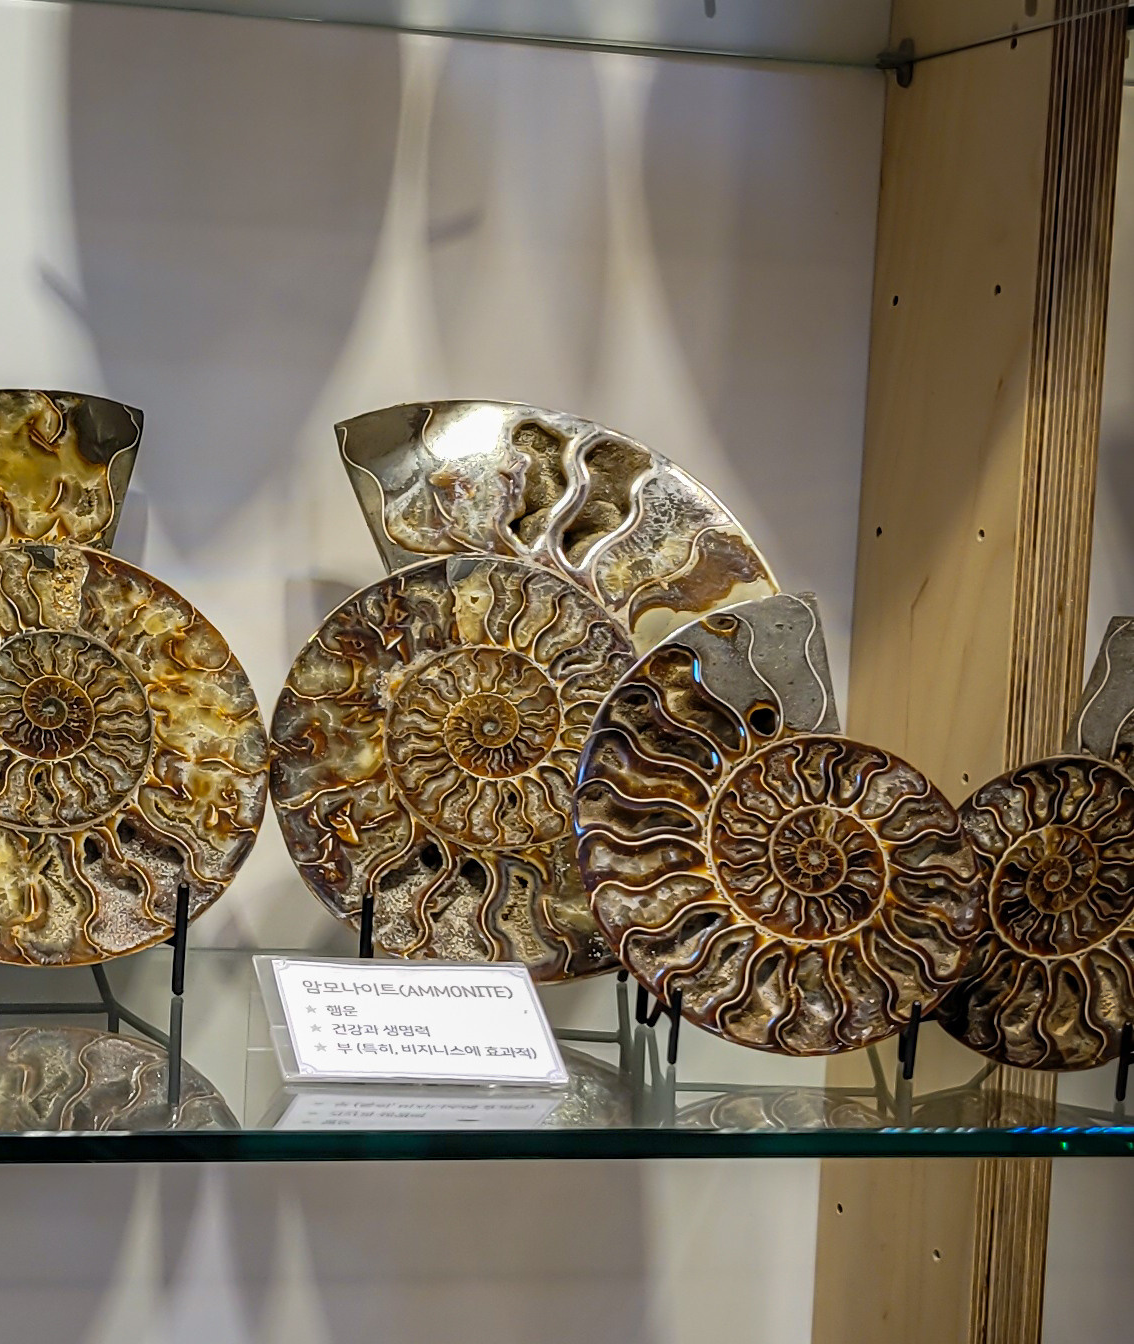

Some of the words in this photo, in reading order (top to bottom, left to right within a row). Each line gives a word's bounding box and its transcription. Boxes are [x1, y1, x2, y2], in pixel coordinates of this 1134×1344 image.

[302, 979, 514, 1000] 암모나이트(AMMONITE)
[326, 1004, 358, 1017] 행운
[332, 1023, 379, 1037] 건강과
[383, 1024, 431, 1038] 생명력
[337, 1043, 354, 1055] 부
[356, 1042, 399, 1057] (특히,
[402, 1043, 481, 1058] 비지니스에
[485, 1045, 538, 1060] 효과적)
